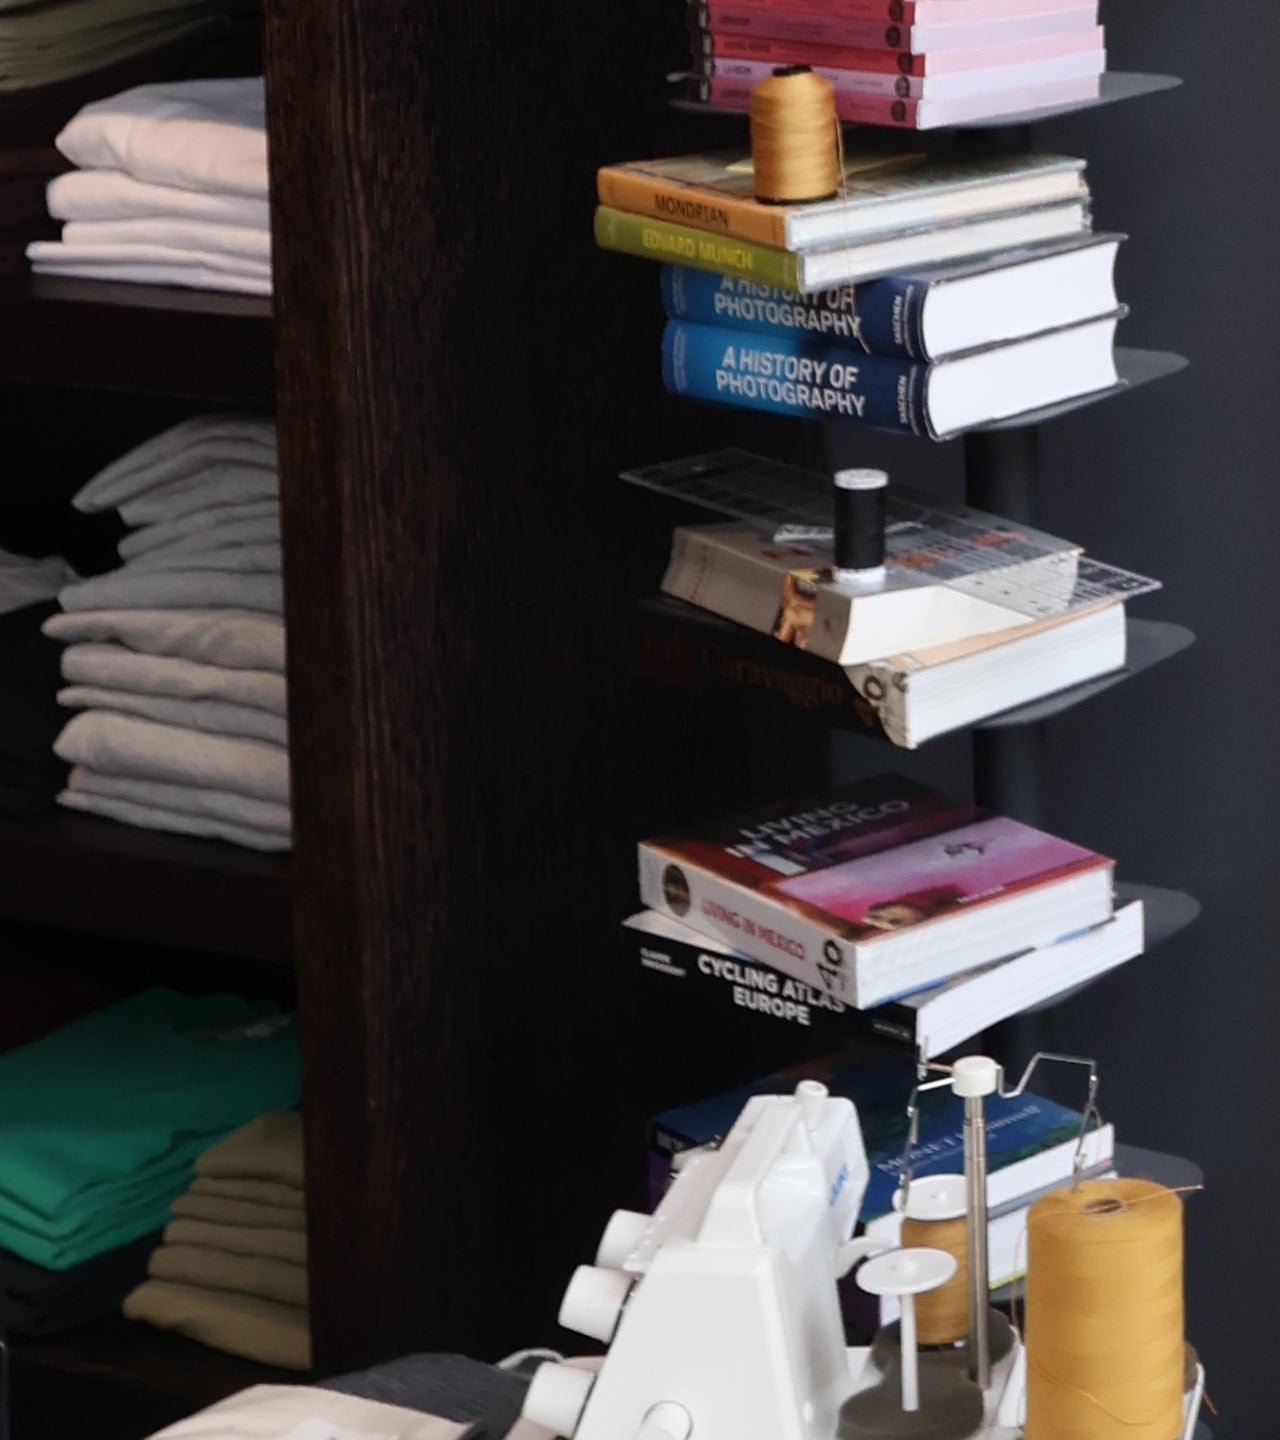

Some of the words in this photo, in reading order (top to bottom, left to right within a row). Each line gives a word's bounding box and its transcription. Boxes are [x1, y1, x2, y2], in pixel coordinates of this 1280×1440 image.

[654, 193, 729, 229] MONDRIAN
[642, 228, 696, 258] EDVARD
[699, 239, 754, 270] MUNCH
[720, 274, 734, 292] A
[713, 292, 862, 337] PHOTOGRAPHY
[722, 345, 736, 368] A
[740, 350, 829, 384] HISTORY
[829, 364, 859, 390] OF
[715, 369, 866, 417] PHOTOGRAPHY
[737, 800, 859, 840] LIVING
[771, 800, 911, 845] MEXICO
[701, 897, 743, 935] LIVING
[744, 916, 758, 937] IN
[757, 920, 807, 961] MEXICO
[697, 952, 781, 995] CYCLING
[780, 976, 847, 1014] ATLAS
[733, 984, 811, 1026] EUROPE
